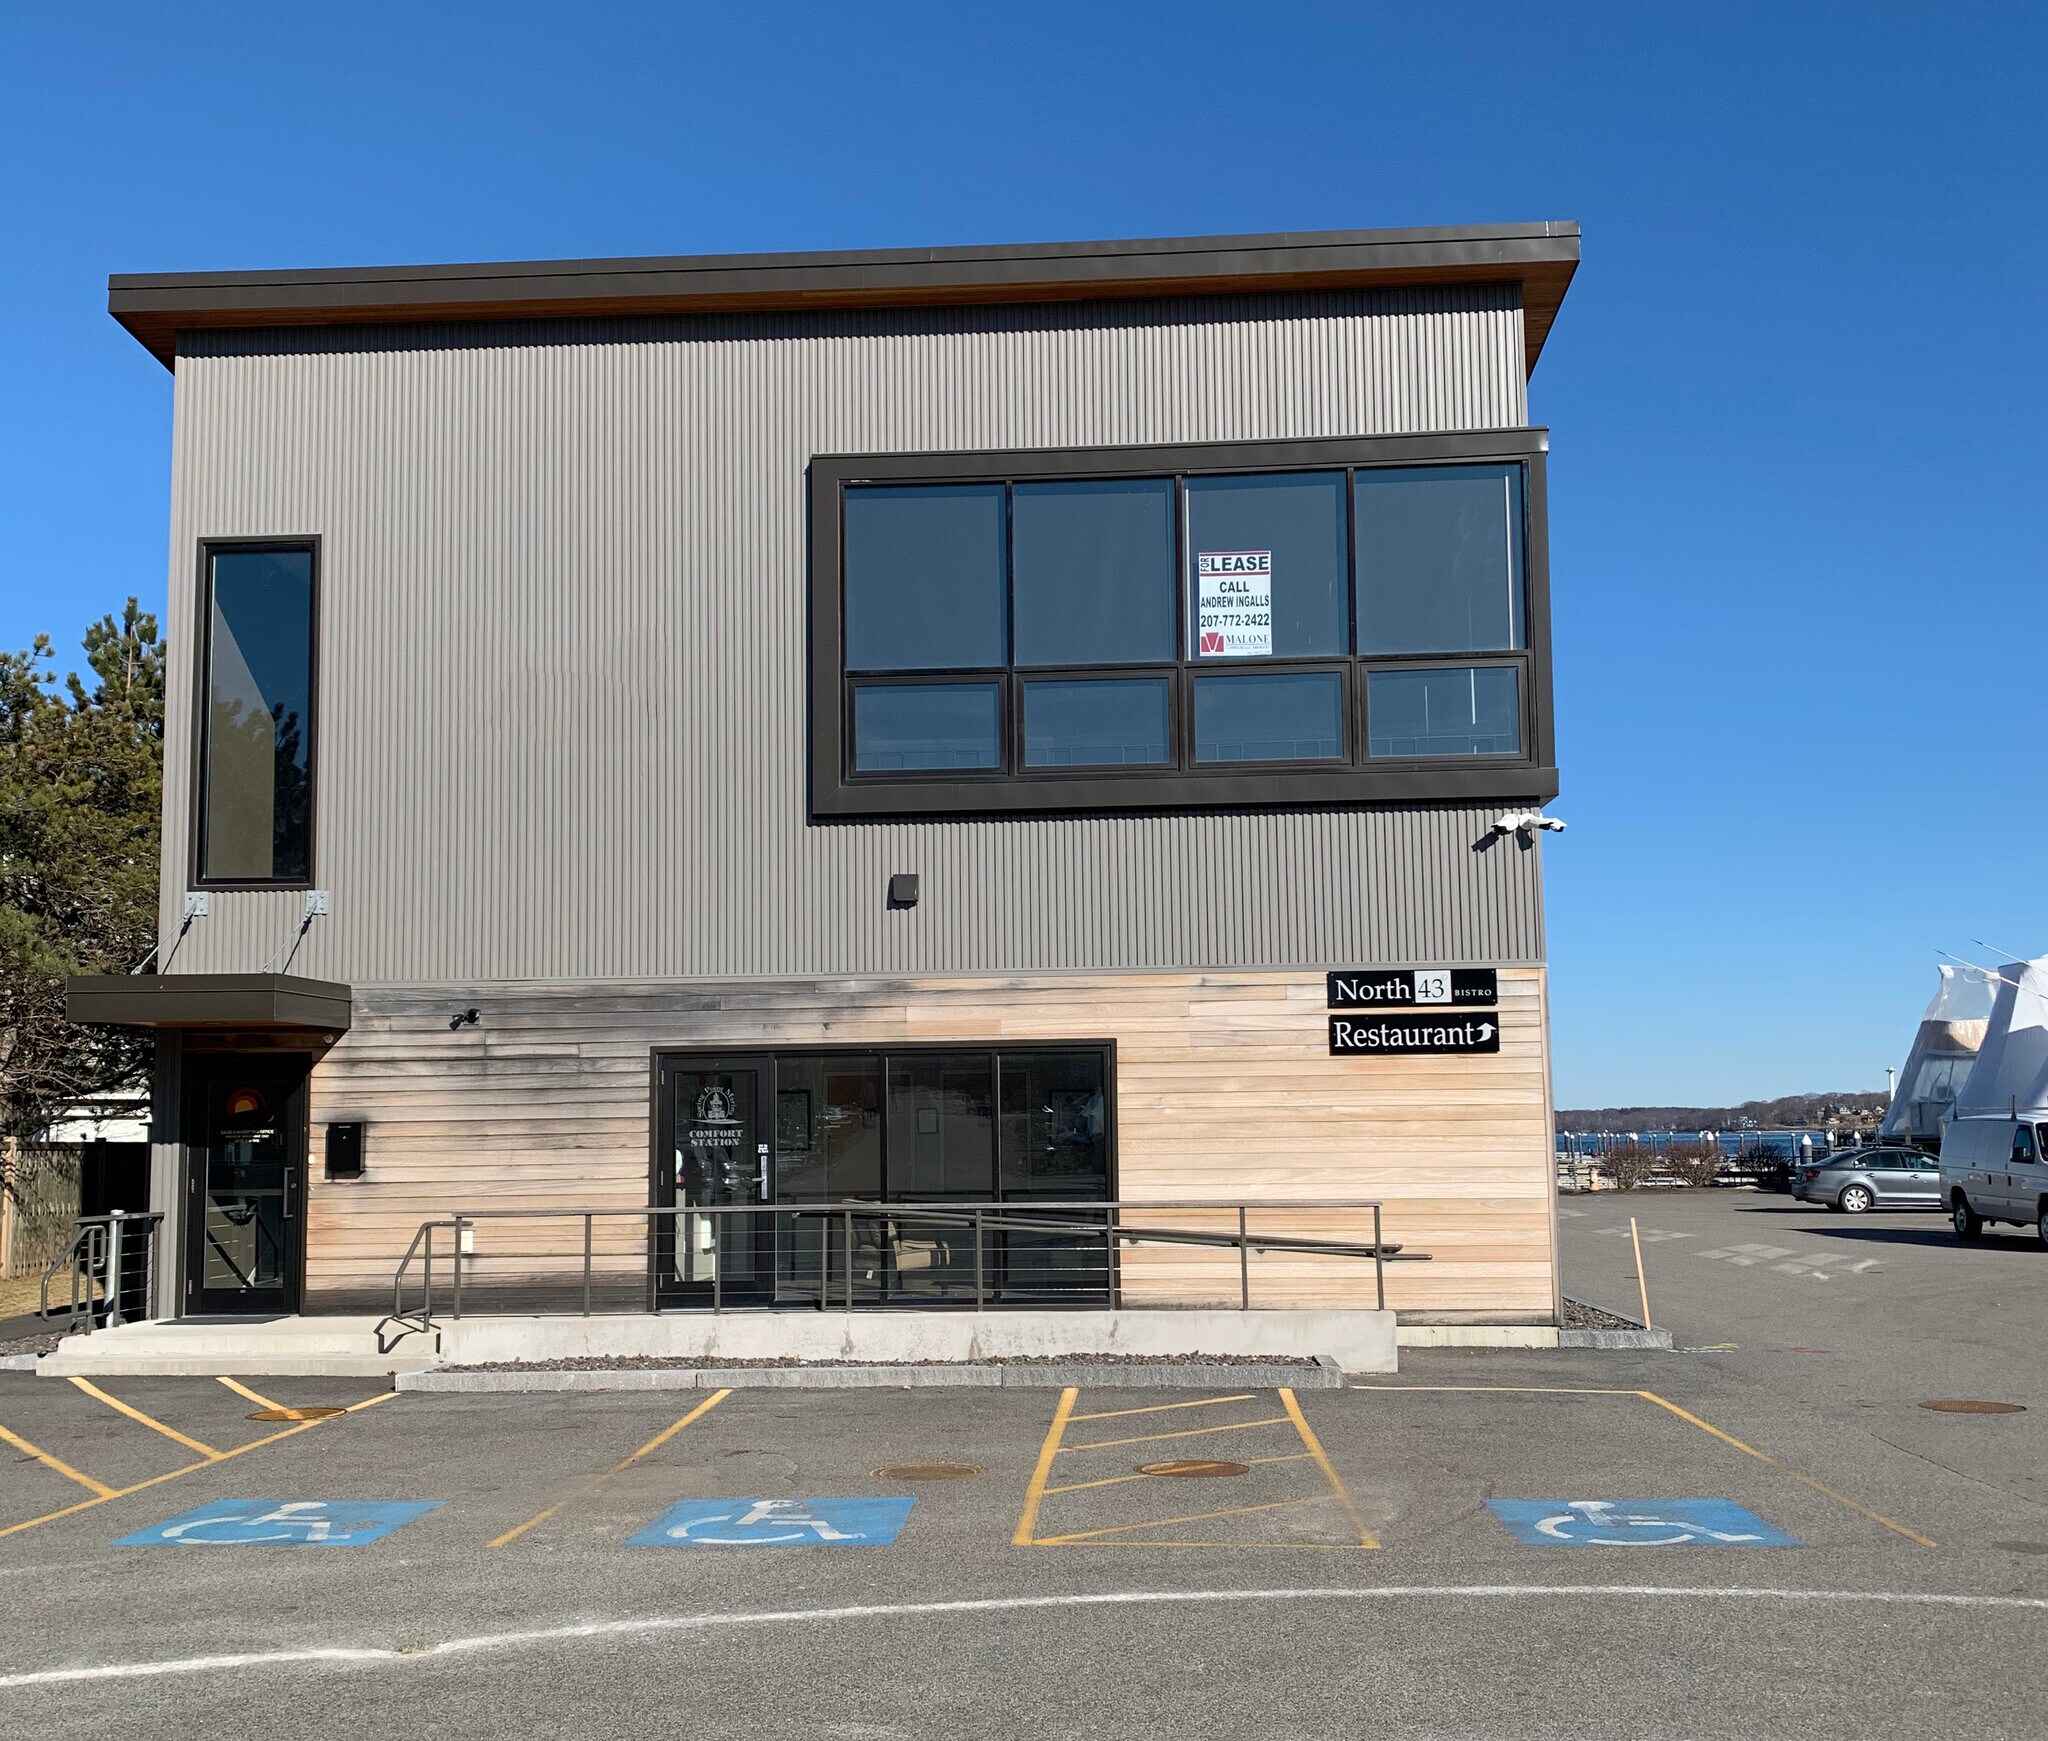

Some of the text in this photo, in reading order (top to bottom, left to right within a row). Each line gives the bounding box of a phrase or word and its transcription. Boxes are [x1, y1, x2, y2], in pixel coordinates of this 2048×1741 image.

[1200, 556, 1269, 572] FOR LEASE
[1219, 581, 1250, 593] CALL
[1200, 594, 1270, 608] ANDREW INGALLS
[1200, 613, 1270, 627] 207-772-2422
[1226, 634, 1270, 644] MALONE
[1335, 978, 1411, 1001] North
[1454, 989, 1492, 997] BISTRO
[1333, 1021, 1475, 1048] Restaurant
[689, 1129, 744, 1138] COMFORT
[690, 1138, 740, 1147] STATION
